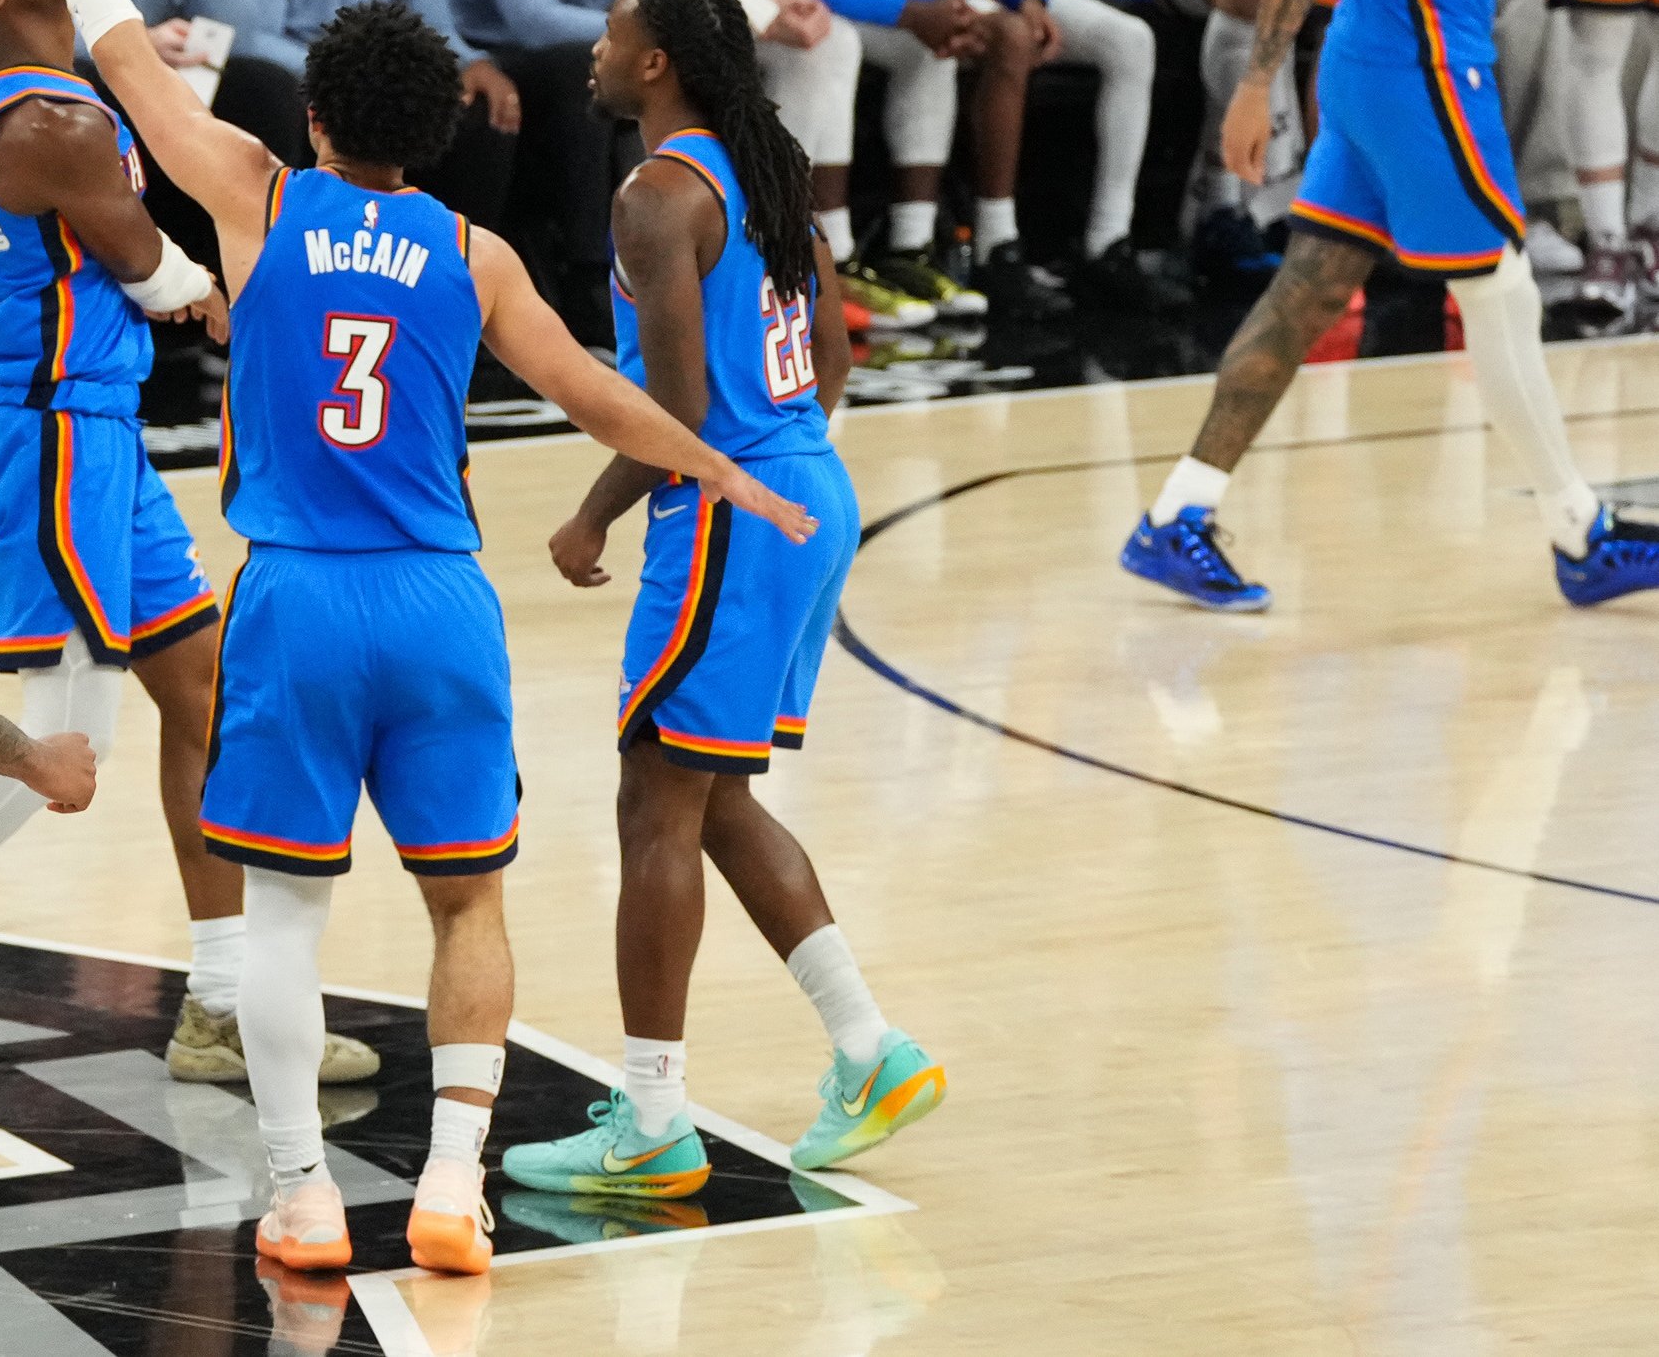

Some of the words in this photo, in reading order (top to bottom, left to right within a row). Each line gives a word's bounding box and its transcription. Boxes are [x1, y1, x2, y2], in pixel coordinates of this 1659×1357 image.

[304, 228, 430, 289] McCAIN
[317, 311, 398, 452] 3
[760, 273, 818, 404] 22
